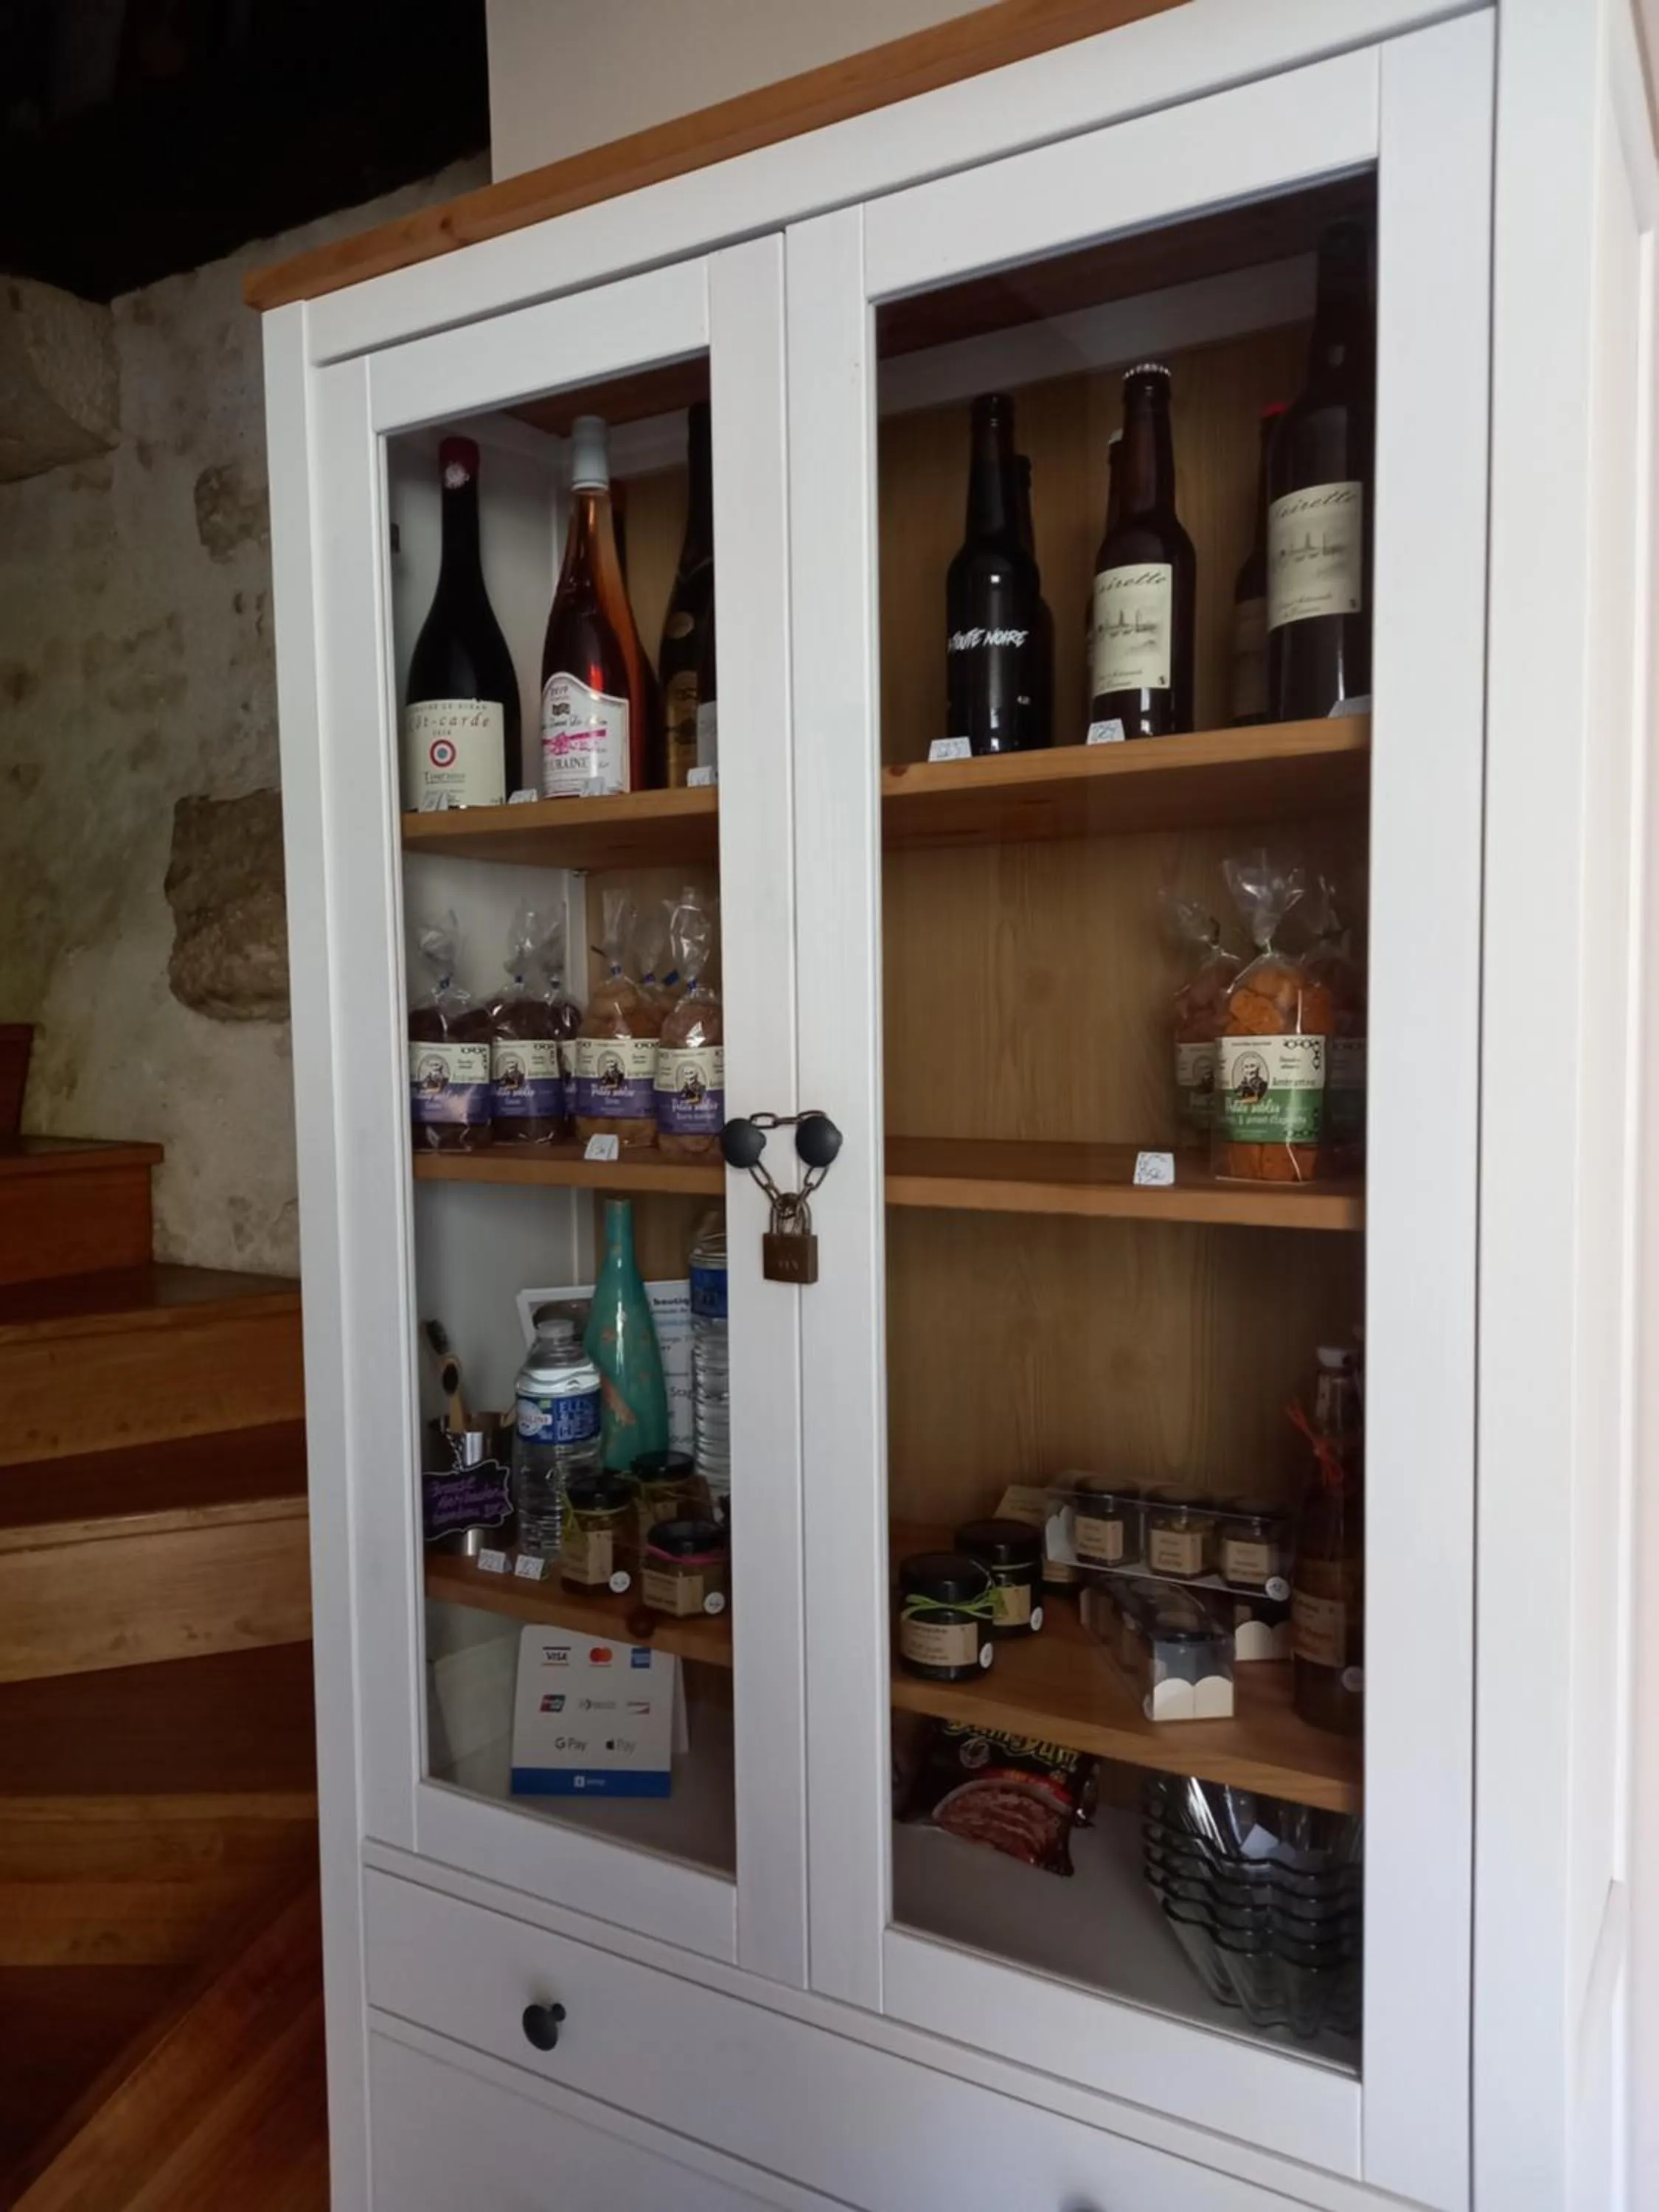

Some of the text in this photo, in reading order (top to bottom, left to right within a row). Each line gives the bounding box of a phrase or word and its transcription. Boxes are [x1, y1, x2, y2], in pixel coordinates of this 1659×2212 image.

[983, 627, 1029, 648] NOIRE
[546, 1651, 567, 1660] VISA
[568, 1738, 588, 1753] Pay
[617, 1739, 636, 1754] Pay
